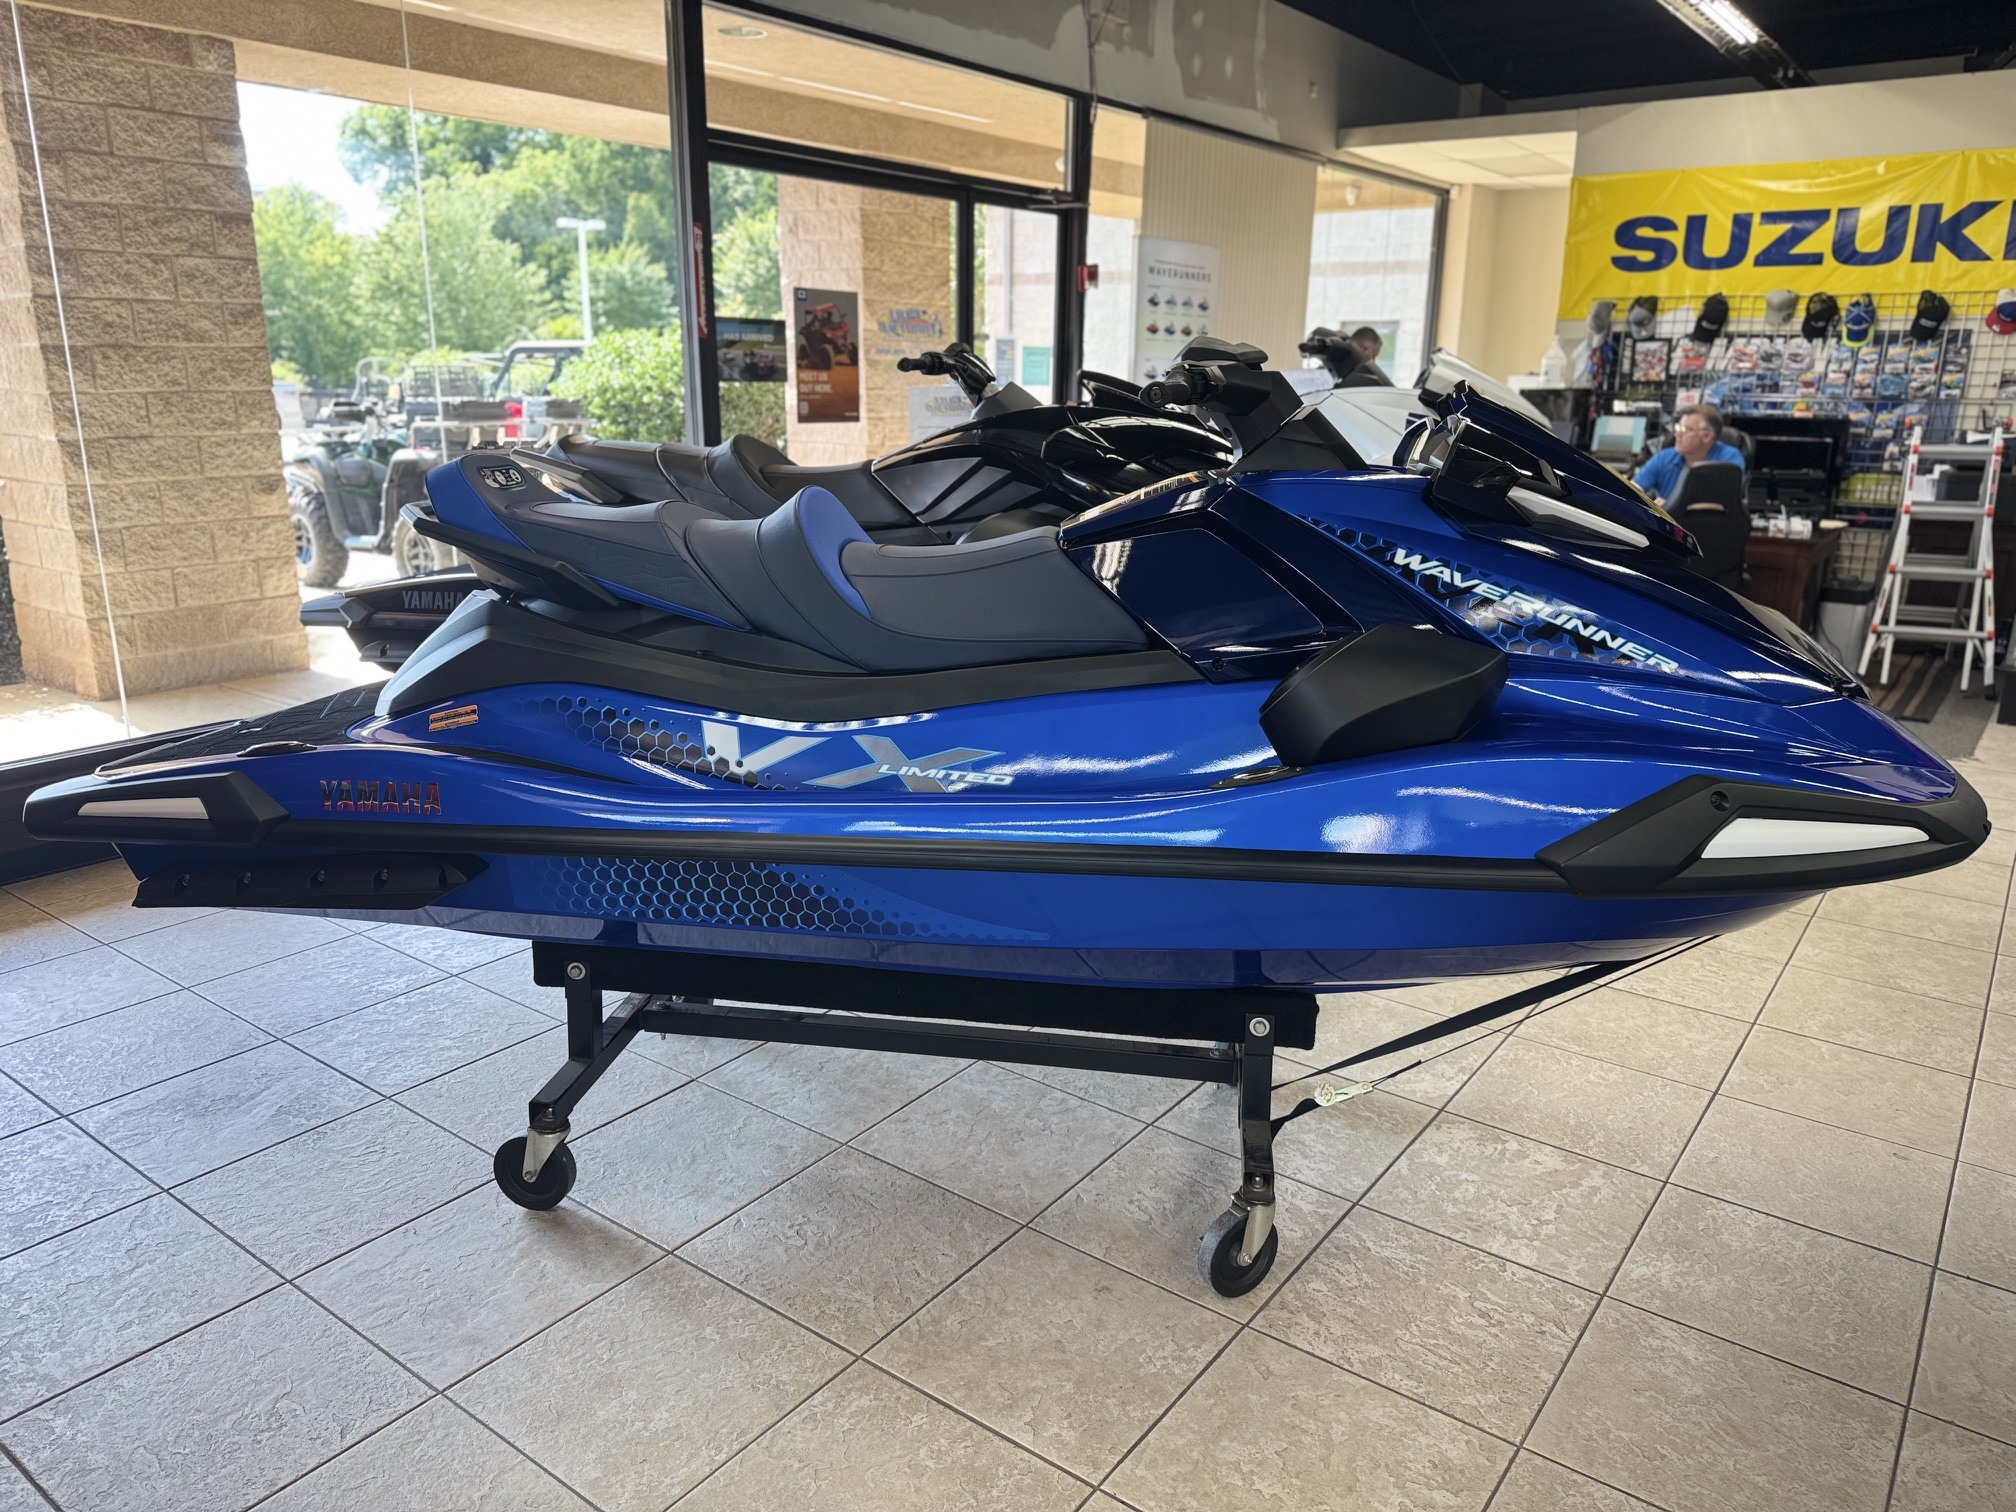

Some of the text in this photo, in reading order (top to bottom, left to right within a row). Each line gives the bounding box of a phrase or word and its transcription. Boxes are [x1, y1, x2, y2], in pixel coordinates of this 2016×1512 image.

[1148, 265, 1211, 283] WAVERUNNERS
[799, 371, 818, 381] MEET
[799, 383, 813, 393] OUT
[1394, 547, 1680, 675] WAVERUNNER
[701, 720, 1003, 793] VX
[876, 763, 1017, 787] LIMITED
[319, 779, 442, 815] YAMAHA
